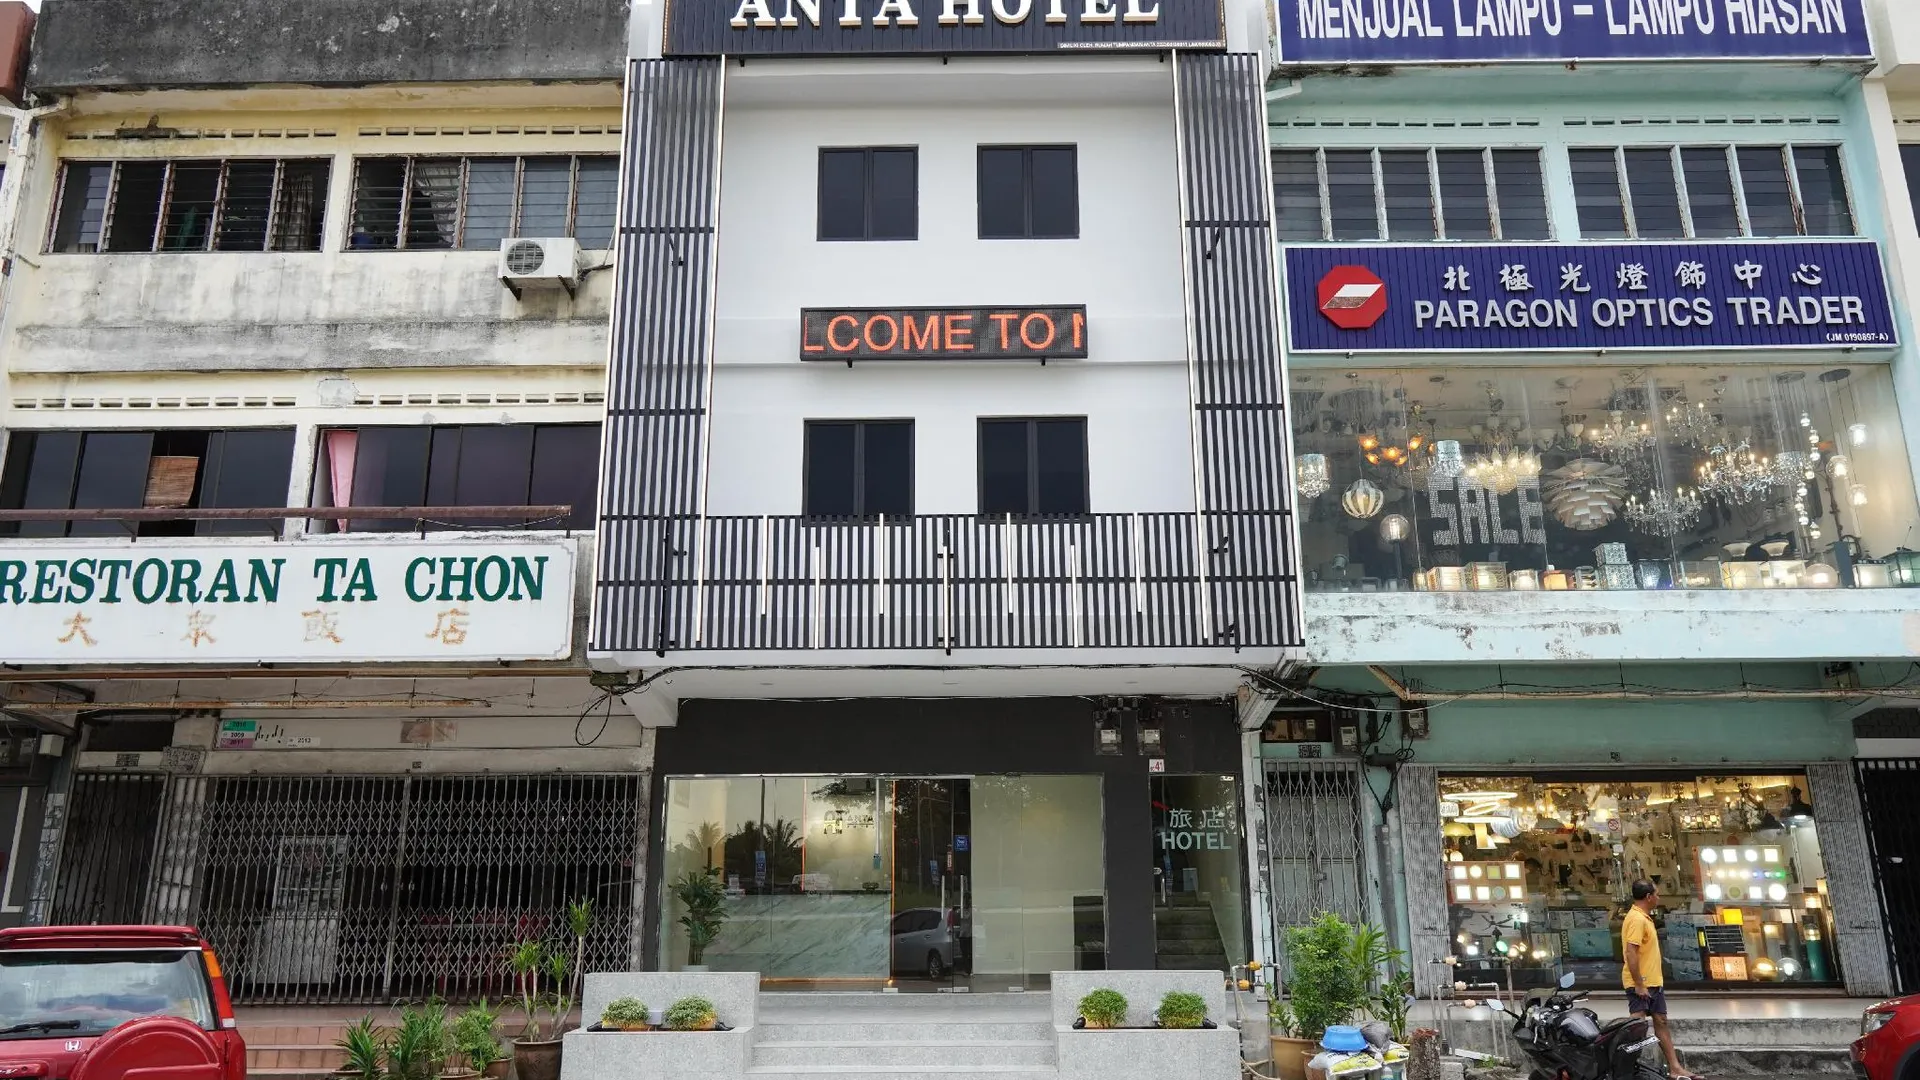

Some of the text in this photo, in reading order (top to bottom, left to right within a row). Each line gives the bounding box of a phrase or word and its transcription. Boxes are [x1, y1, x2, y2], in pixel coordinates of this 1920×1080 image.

[938, 0, 1160, 25] HOTEL
[1300, 0, 1443, 39] MENJUAL
[1454, 0, 1562, 37] LAMPU
[1606, 0, 1715, 35] LAMPU
[1725, 0, 1847, 35] HIASAN
[1443, 260, 1822, 293] 北極光燈飾中心
[1414, 296, 1866, 329] PARAGON OPTICS TRADER
[989, 312, 1056, 350] TO
[1427, 474, 1547, 545] SALE
[0, 555, 549, 605] RESTORAN TA CHON
[1169, 806, 1226, 829] 旅店
[1160, 831, 1232, 850] HOTEL
